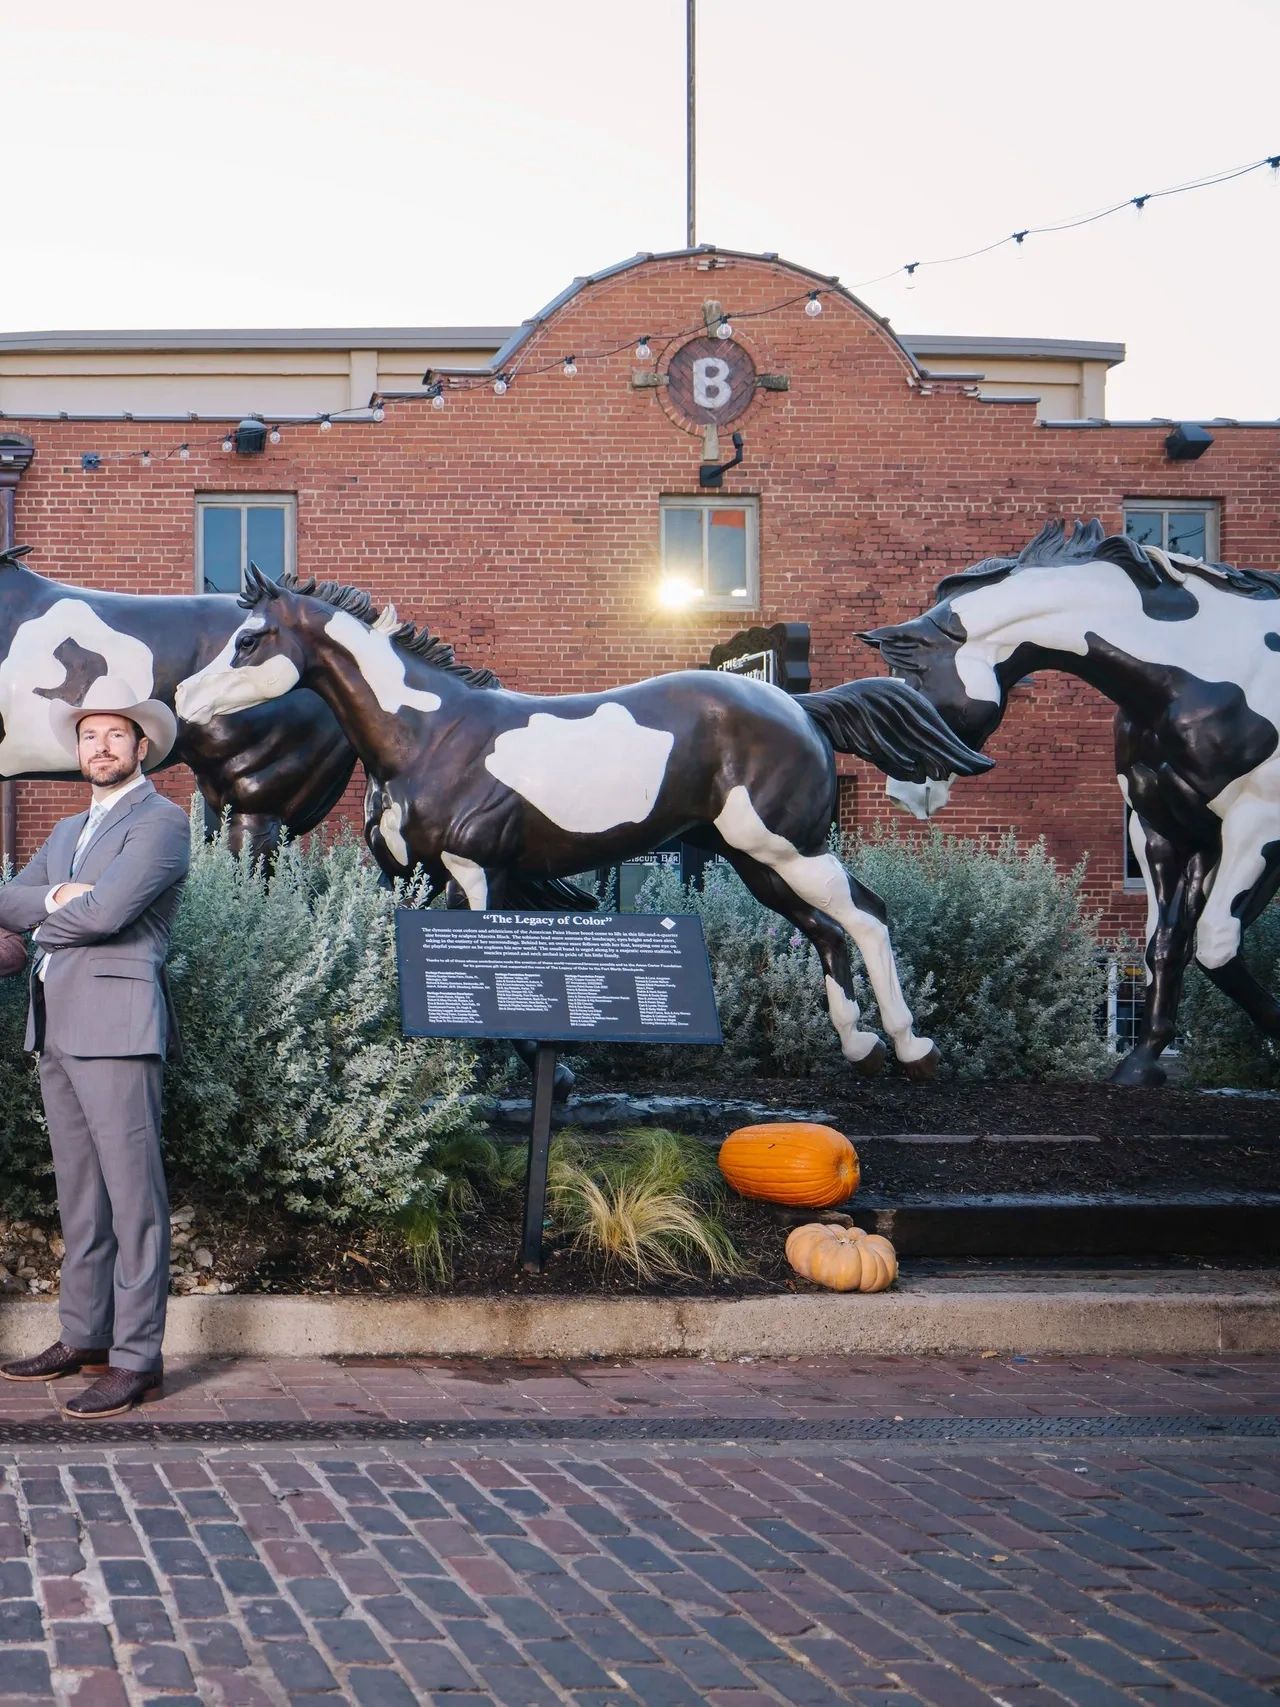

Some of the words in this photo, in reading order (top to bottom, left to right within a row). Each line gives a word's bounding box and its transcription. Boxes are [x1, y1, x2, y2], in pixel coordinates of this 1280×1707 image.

[693, 357, 732, 408] B
[515, 915, 554, 926] Legacy
[557, 916, 570, 925] of
